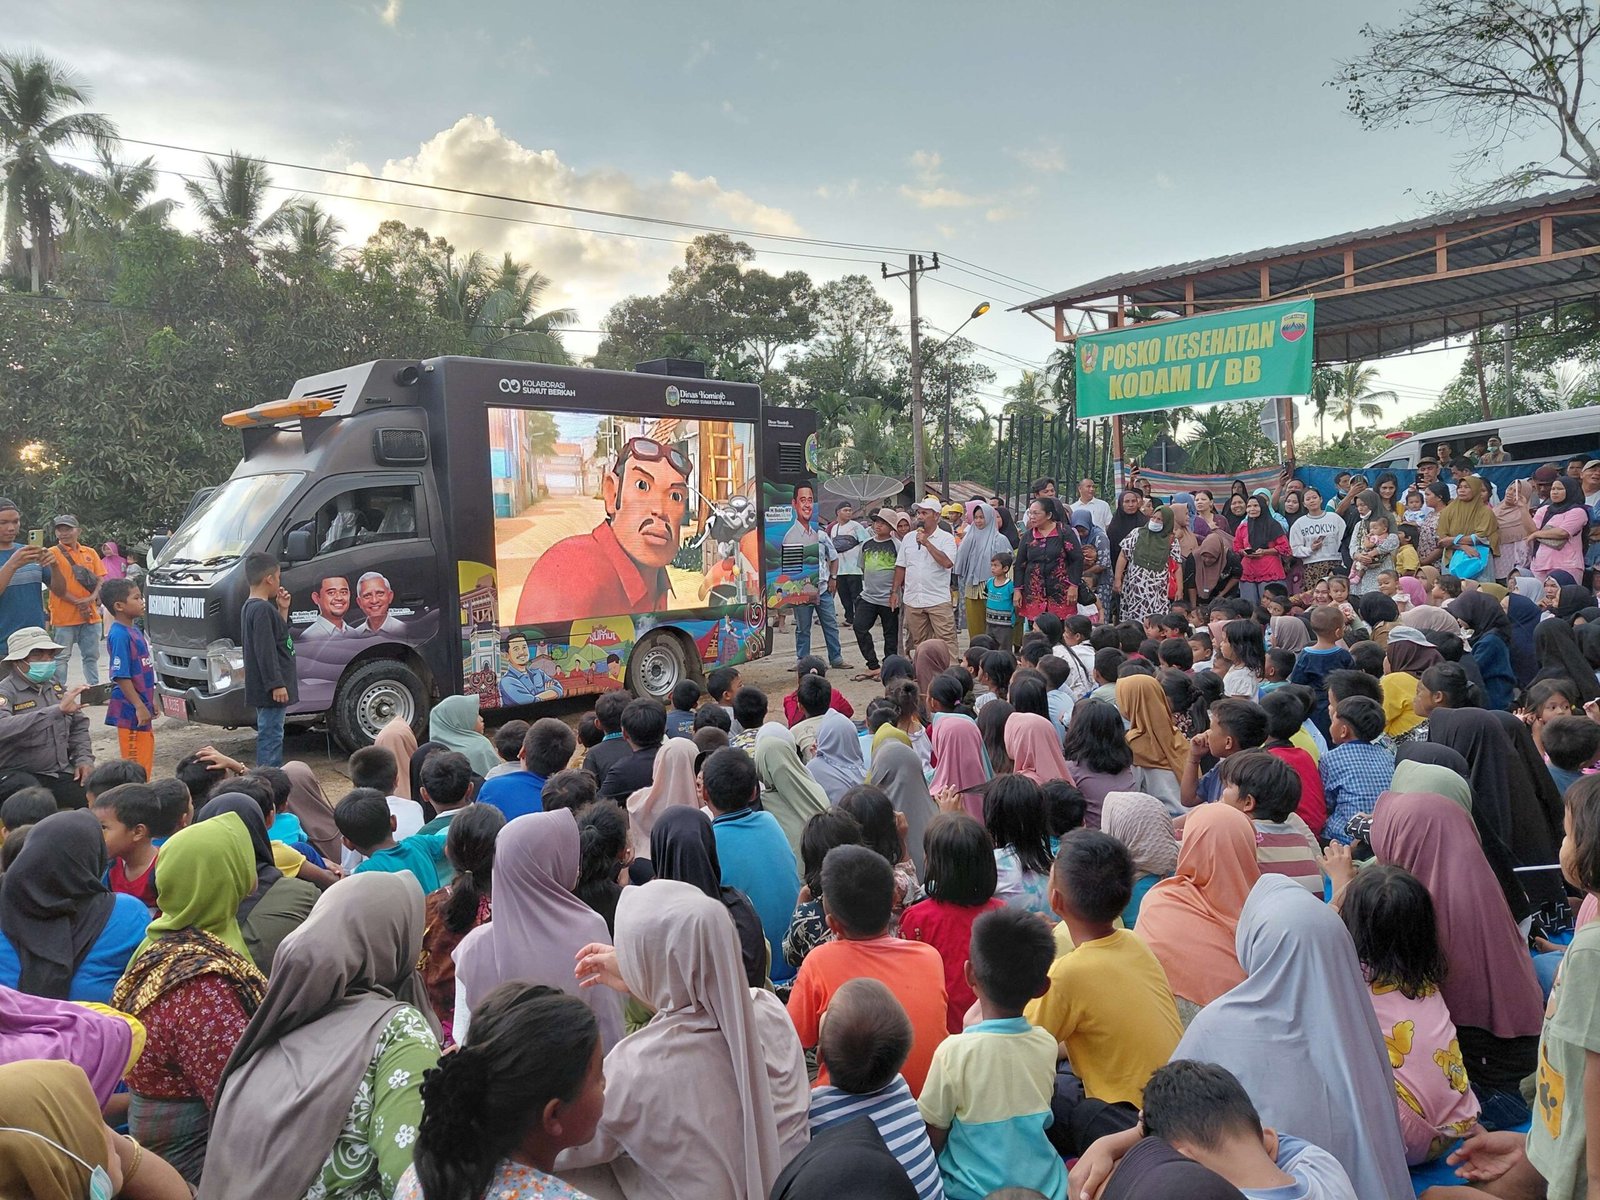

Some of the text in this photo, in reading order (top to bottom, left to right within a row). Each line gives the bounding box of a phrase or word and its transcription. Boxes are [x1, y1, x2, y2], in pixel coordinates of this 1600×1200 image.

[1102, 320, 1276, 371] POSKO KESEHATAN
[522, 379, 566, 389] KOLABORASI
[1109, 364, 1192, 401] KODAM
[1224, 355, 1262, 386] BB
[522, 386, 576, 397] SUMUT BERKAH
[680, 390, 699, 398] Dinas
[180, 596, 206, 619] SUMUT
